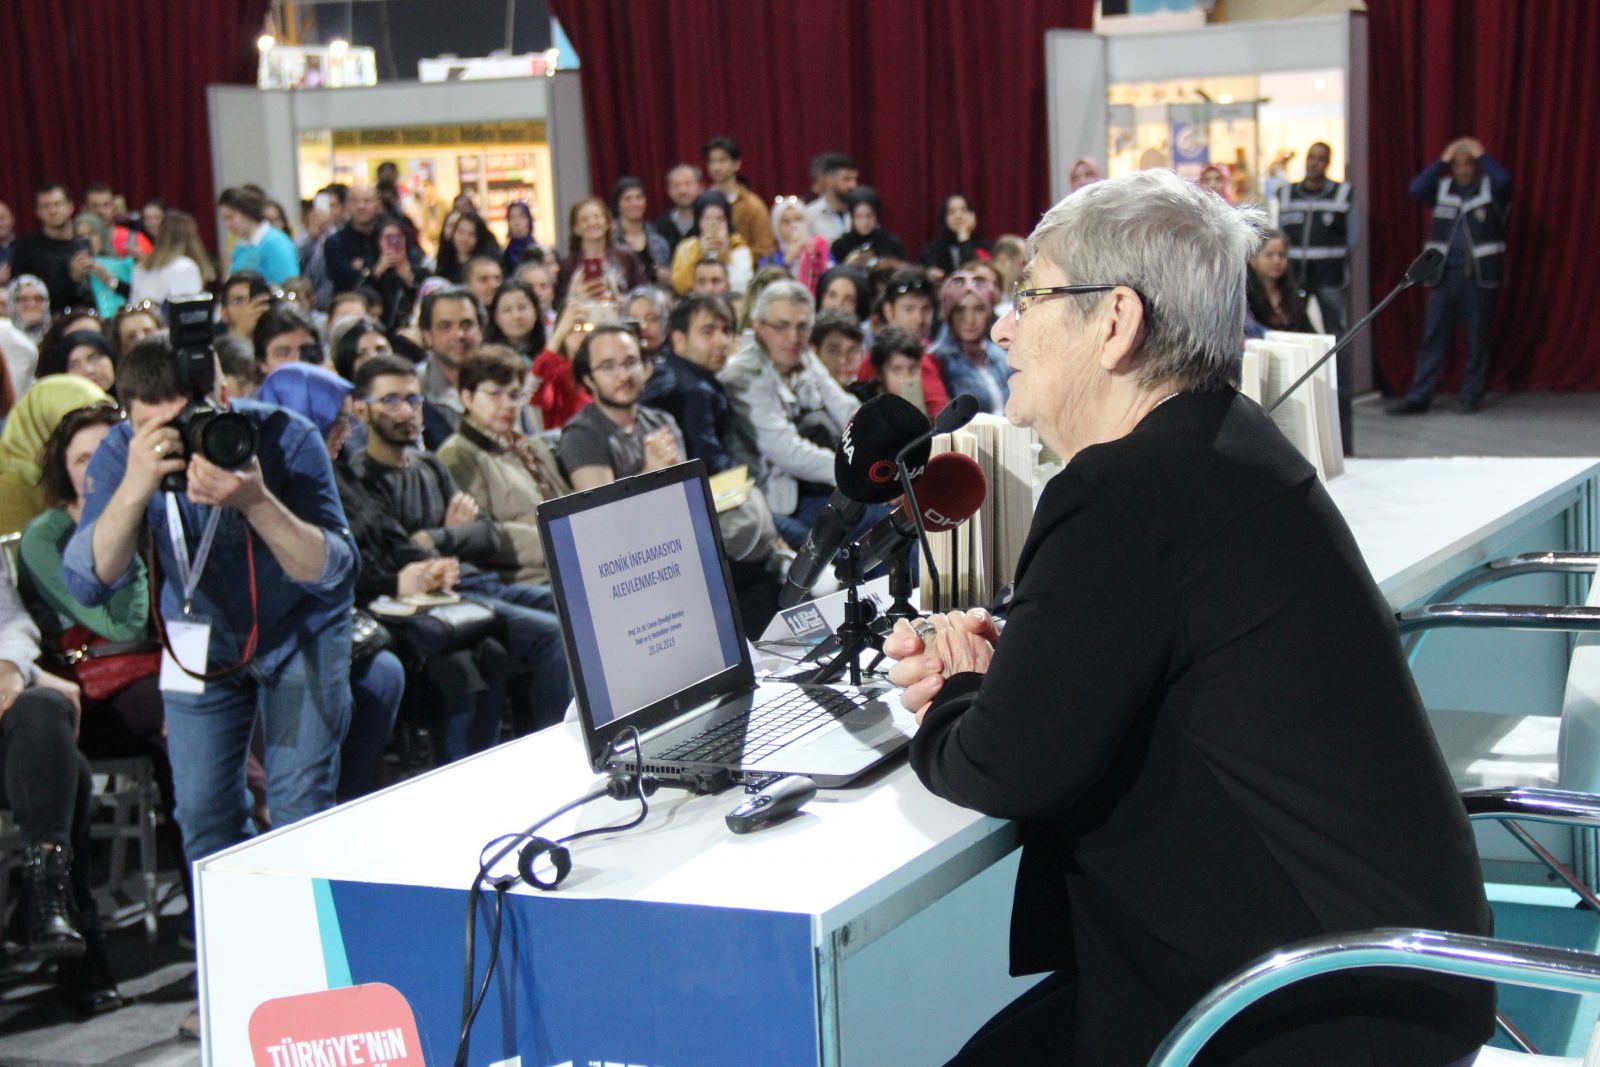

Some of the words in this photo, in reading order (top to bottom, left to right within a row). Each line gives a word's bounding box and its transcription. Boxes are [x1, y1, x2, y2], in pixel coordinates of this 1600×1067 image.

[598, 554, 630, 578] KRONİK
[628, 538, 683, 568] İNFLAMASYON
[612, 562, 682, 600] ALEVLENME-NEDİR
[266, 1027, 407, 1067] TÜRKİYE'NİN
